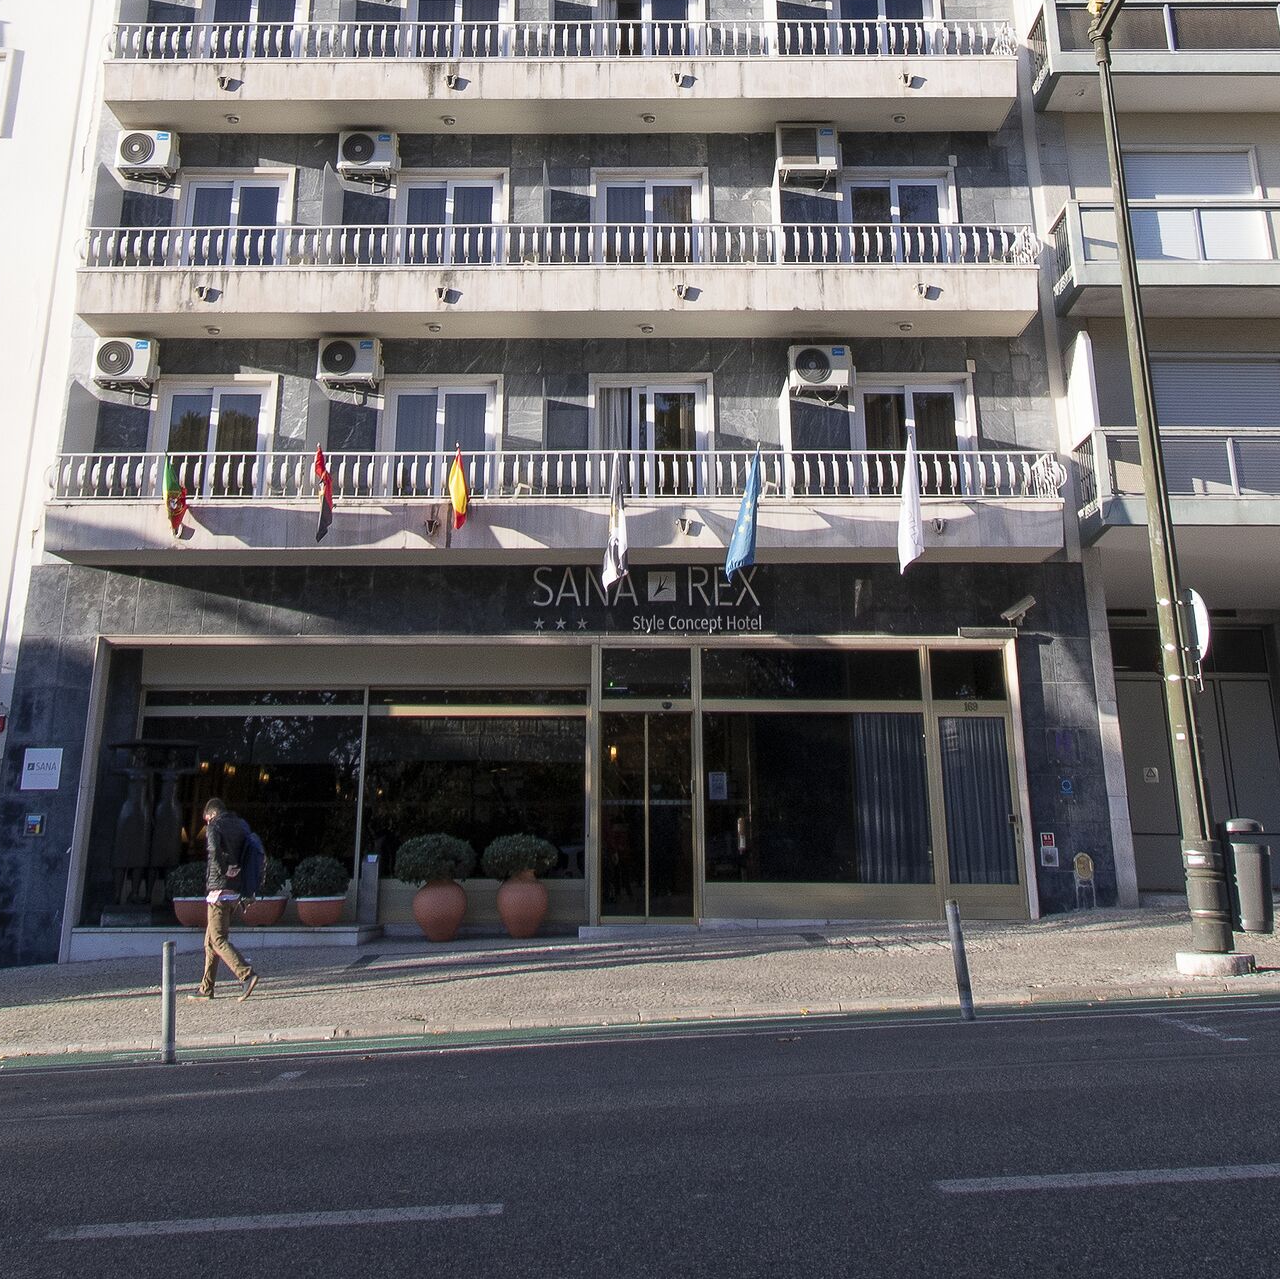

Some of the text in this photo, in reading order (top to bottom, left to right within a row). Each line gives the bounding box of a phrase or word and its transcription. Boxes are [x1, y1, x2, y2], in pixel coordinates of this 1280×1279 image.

[532, 565, 761, 607] SANA REX
[632, 614, 762, 633] Style Concept Hotel
[36, 762, 57, 771] SANA
